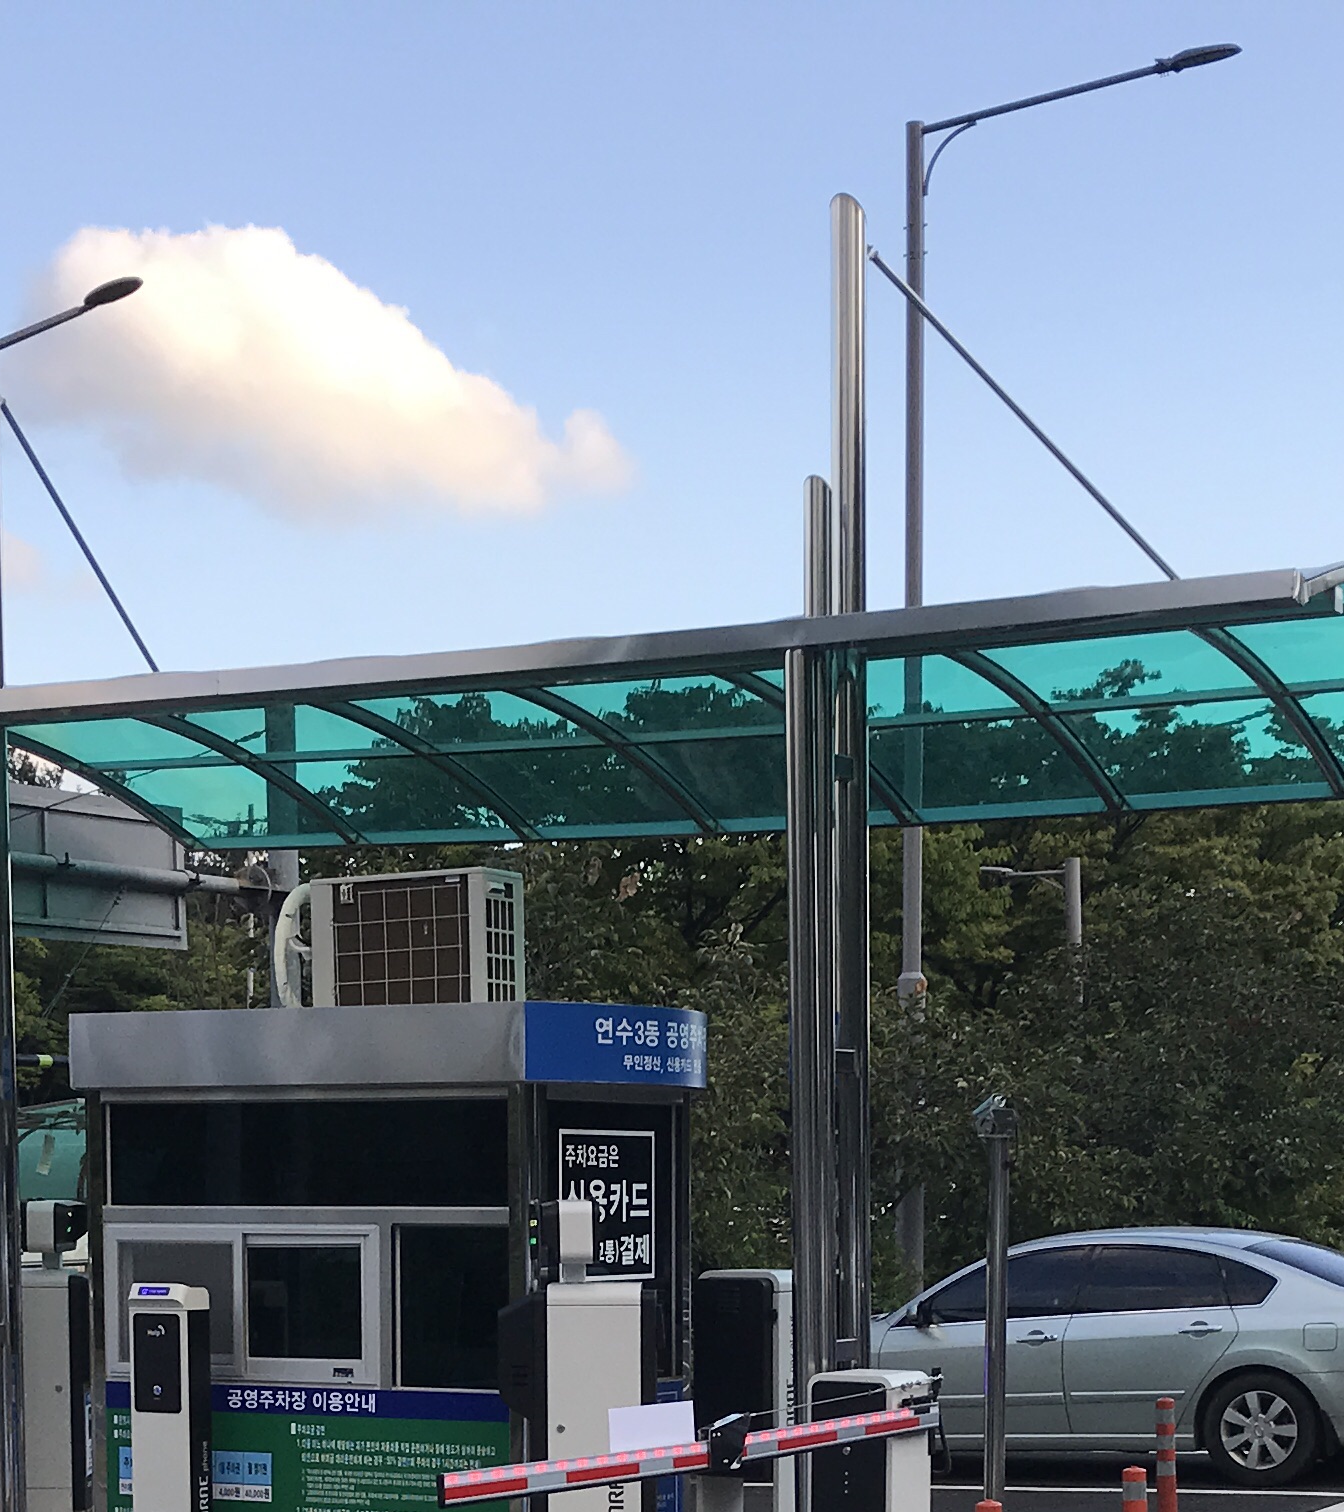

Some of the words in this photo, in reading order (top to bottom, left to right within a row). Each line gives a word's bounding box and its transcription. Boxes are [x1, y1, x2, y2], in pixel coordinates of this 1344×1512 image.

[595, 1017, 660, 1047] 연수3동
[565, 1144, 619, 1168] 주차요금은
[227, 1388, 307, 1411] 공영주차장
[312, 1390, 376, 1413] 이용안내
